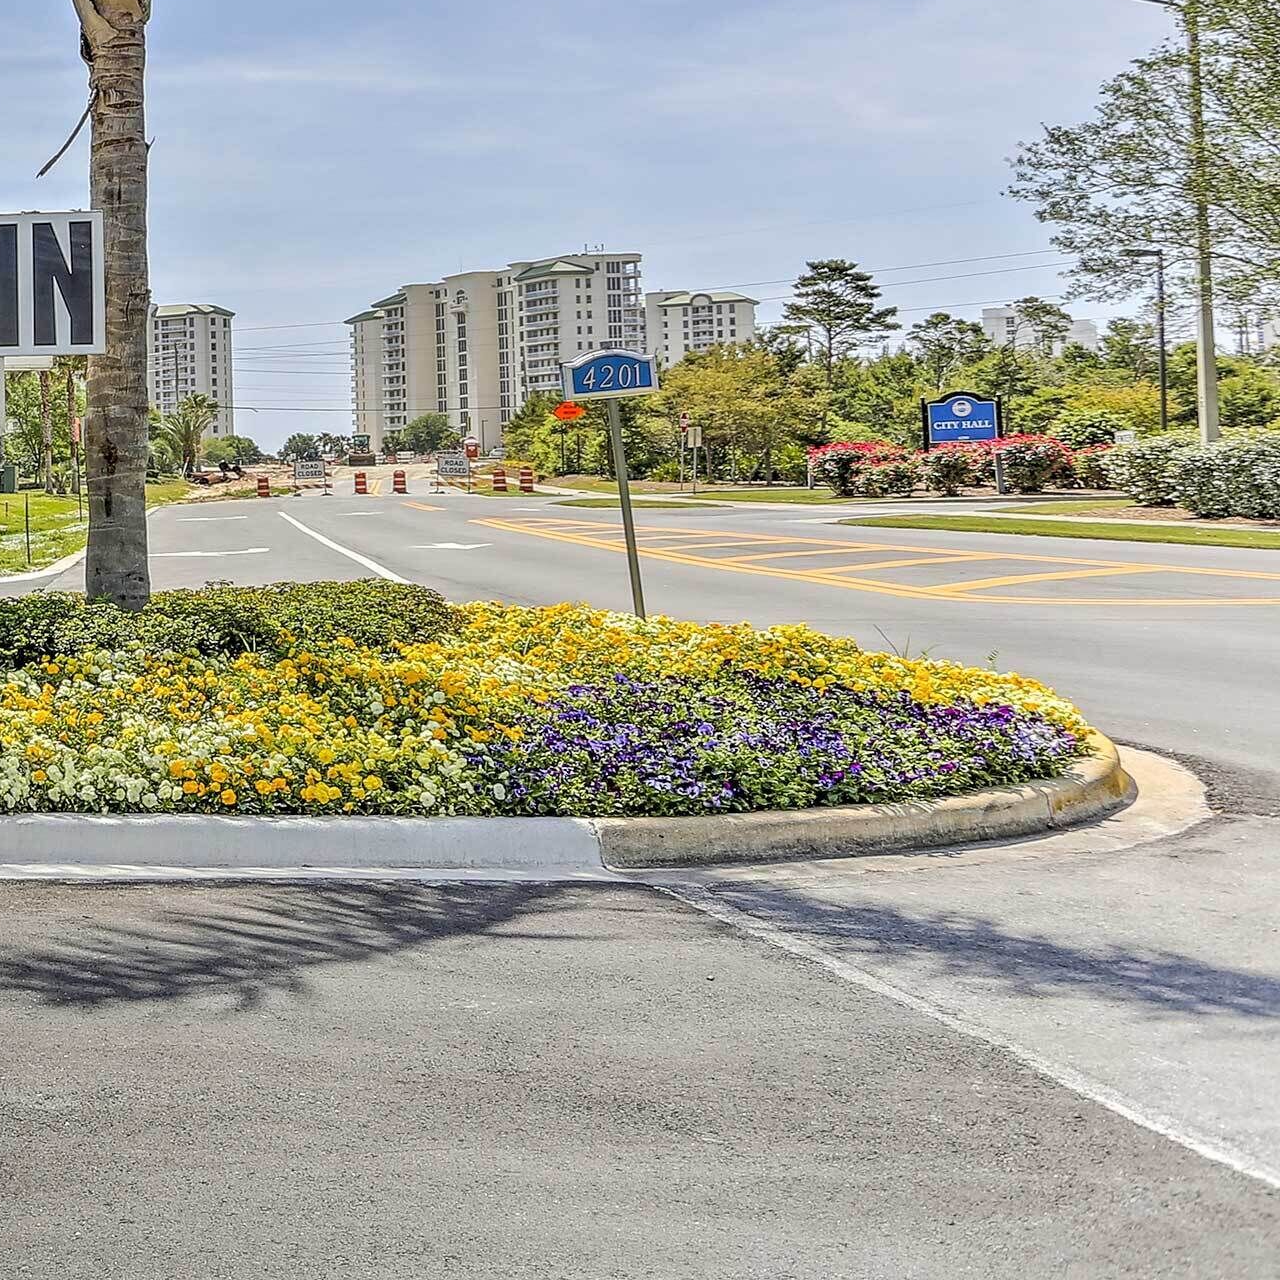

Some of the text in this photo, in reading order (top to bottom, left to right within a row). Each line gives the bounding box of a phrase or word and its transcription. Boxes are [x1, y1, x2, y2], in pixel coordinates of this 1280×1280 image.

[582, 362, 642, 390] 4201
[933, 420, 993, 430] CITY HALL
